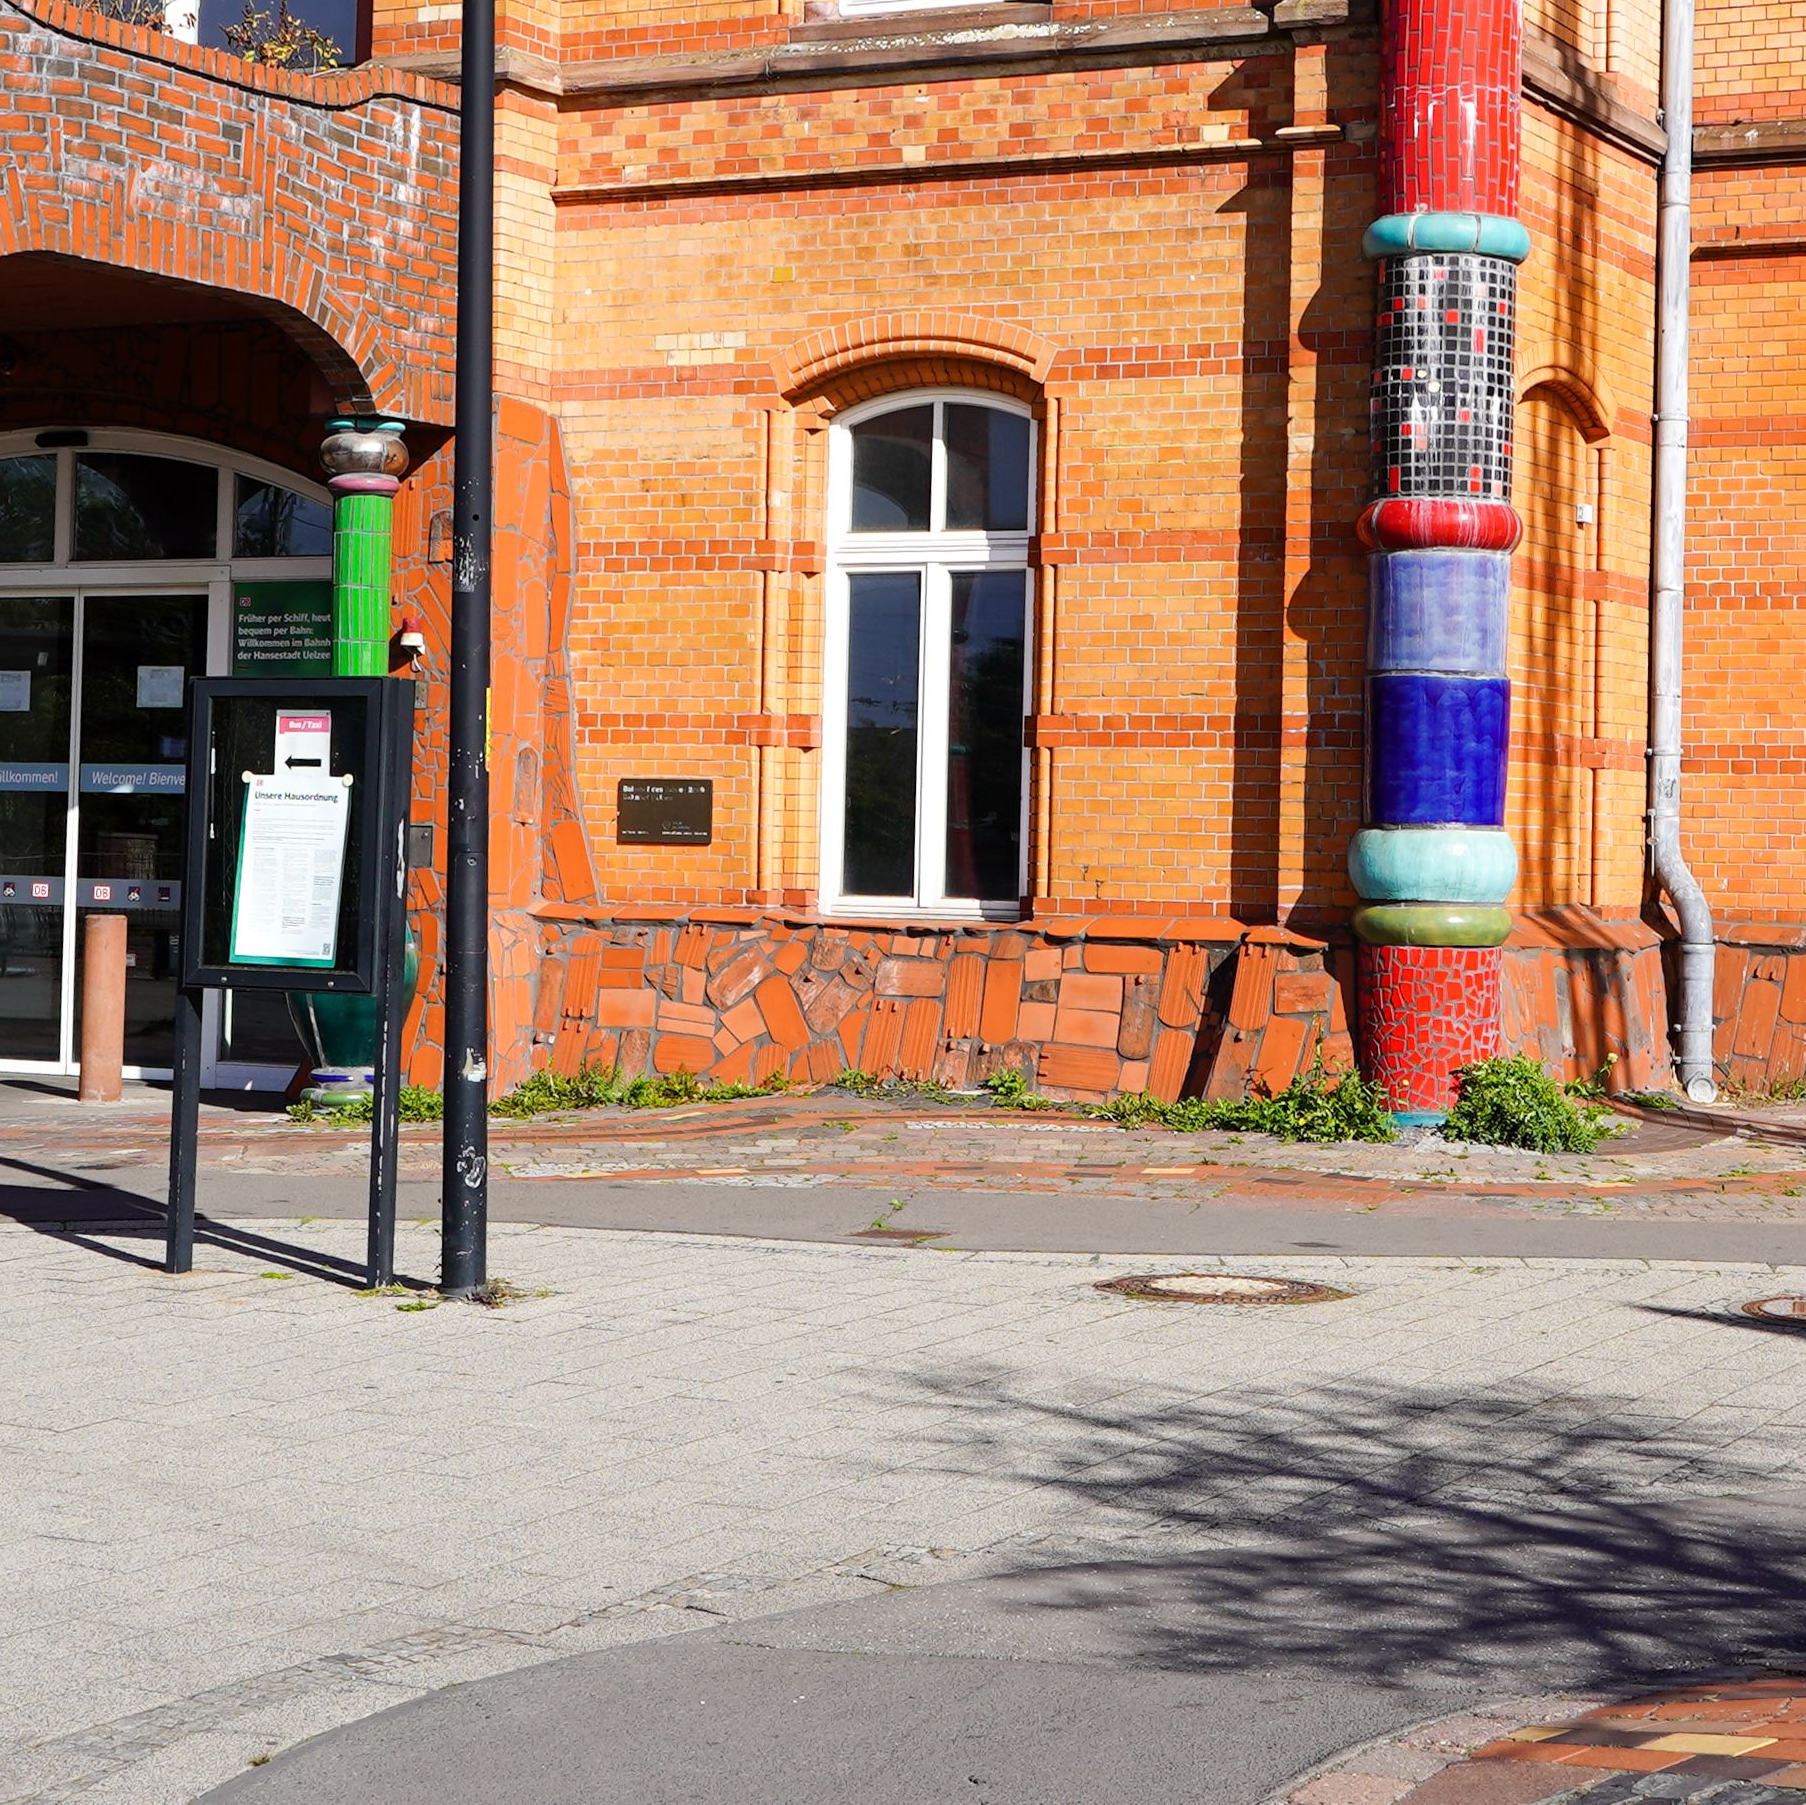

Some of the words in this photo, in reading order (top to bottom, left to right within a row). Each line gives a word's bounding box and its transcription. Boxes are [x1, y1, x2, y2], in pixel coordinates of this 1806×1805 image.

[238, 613, 266, 623] Früher
[267, 615, 282, 624] per
[284, 613, 310, 623] Schiff,
[311, 614, 332, 623] heut
[238, 626, 272, 637] bequem
[273, 628, 288, 637] per
[289, 626, 314, 635] Bahn:
[238, 639, 290, 648] Willkommen
[292, 639, 303, 647] im
[304, 639, 332, 647] Bahnh
[237, 651, 252, 660] der
[253, 651, 301, 660] Hansestadt
[92, 771, 147, 785] Welcome!
[148, 772, 186, 786] Bienve
[254, 791, 282, 800] Unsere
[284, 792, 338, 804] Hausordnung
[34, 885, 47, 896] DB
[95, 888, 109, 898] DB
